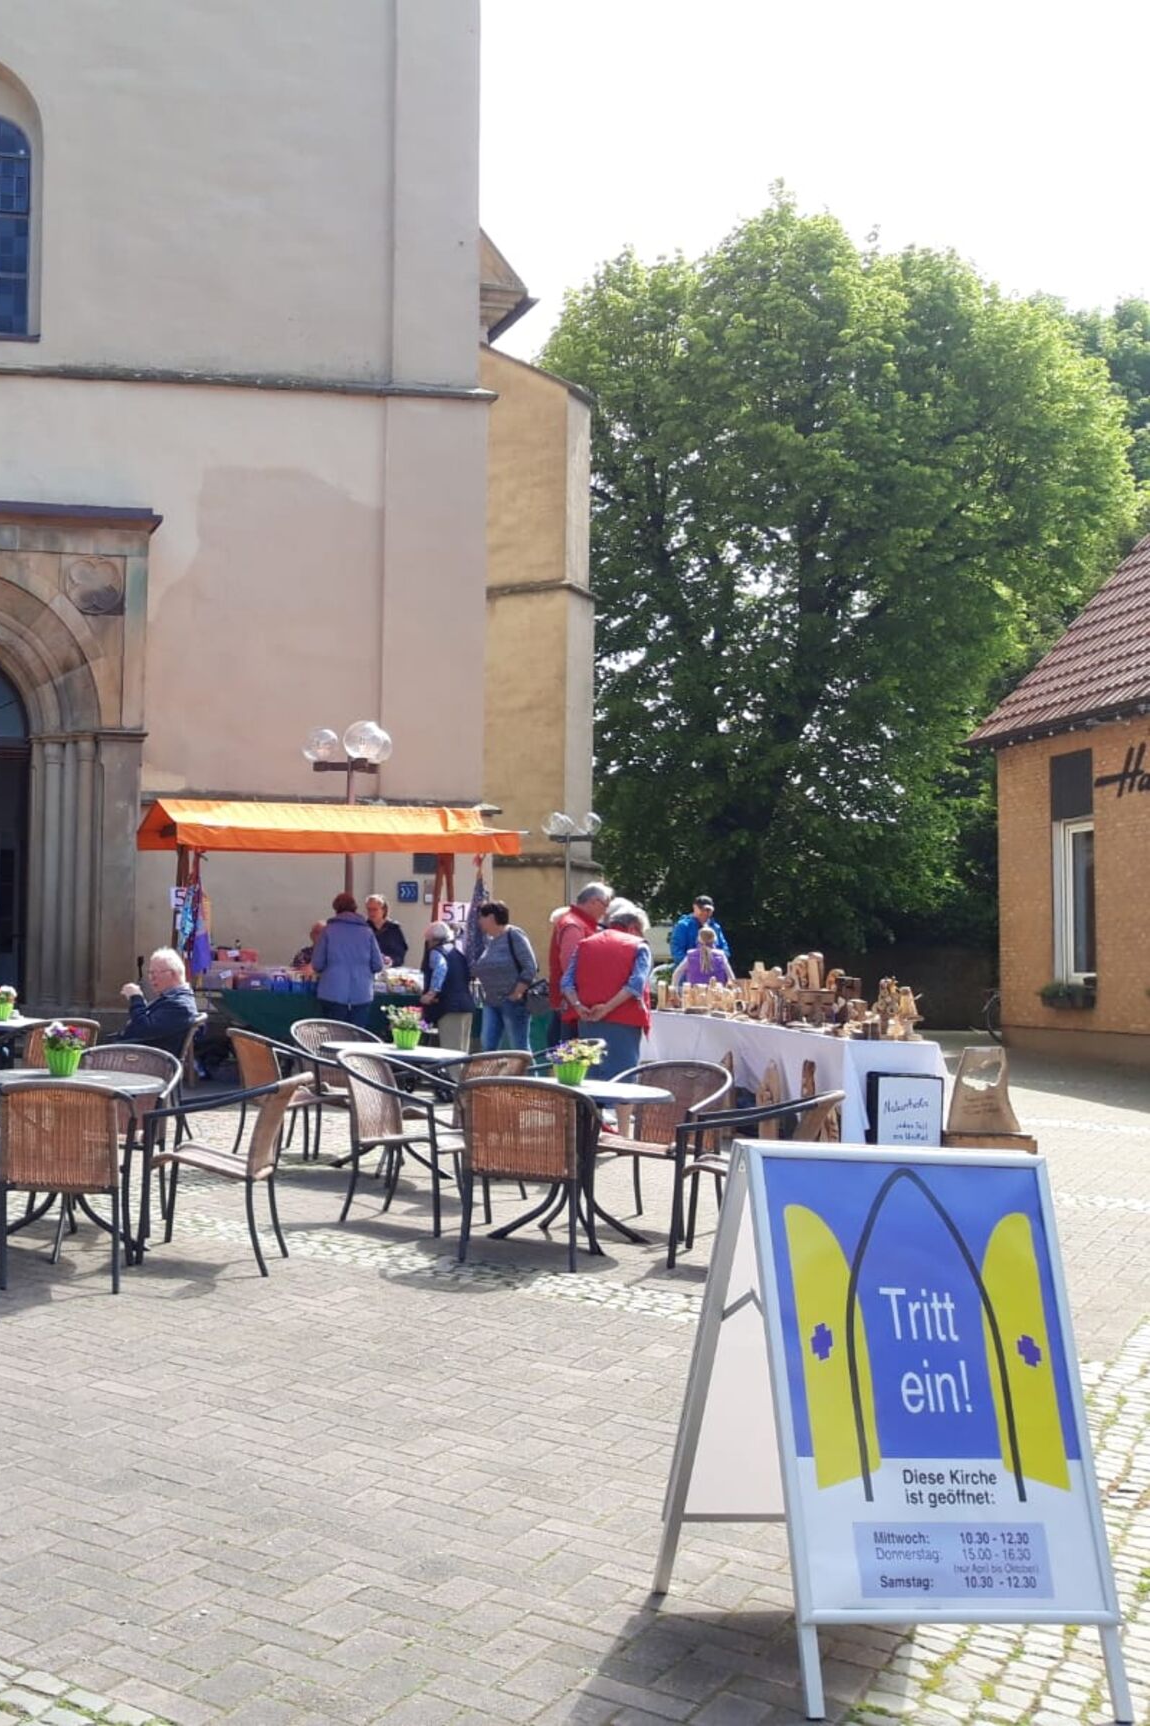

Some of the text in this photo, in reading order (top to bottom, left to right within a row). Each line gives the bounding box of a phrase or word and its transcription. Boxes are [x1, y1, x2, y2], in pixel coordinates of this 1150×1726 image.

[442, 903, 466, 922] 51
[879, 1287, 959, 1342] Tritt
[900, 1360, 973, 1414] ein!
[903, 1469, 998, 1485] Diese Kirche
[906, 1489, 996, 1508] ist geöffnet:
[873, 1531, 930, 1545] Mittwoch:
[960, 1532, 989, 1545] 10.30
[1001, 1532, 1030, 1545] 12.30
[875, 1547, 943, 1562] Donnerstag:
[962, 1548, 992, 1561] 15.00
[880, 1575, 934, 1590] Samstag:
[964, 1576, 993, 1588] 10.30
[1007, 1576, 1037, 1588] 12.30
